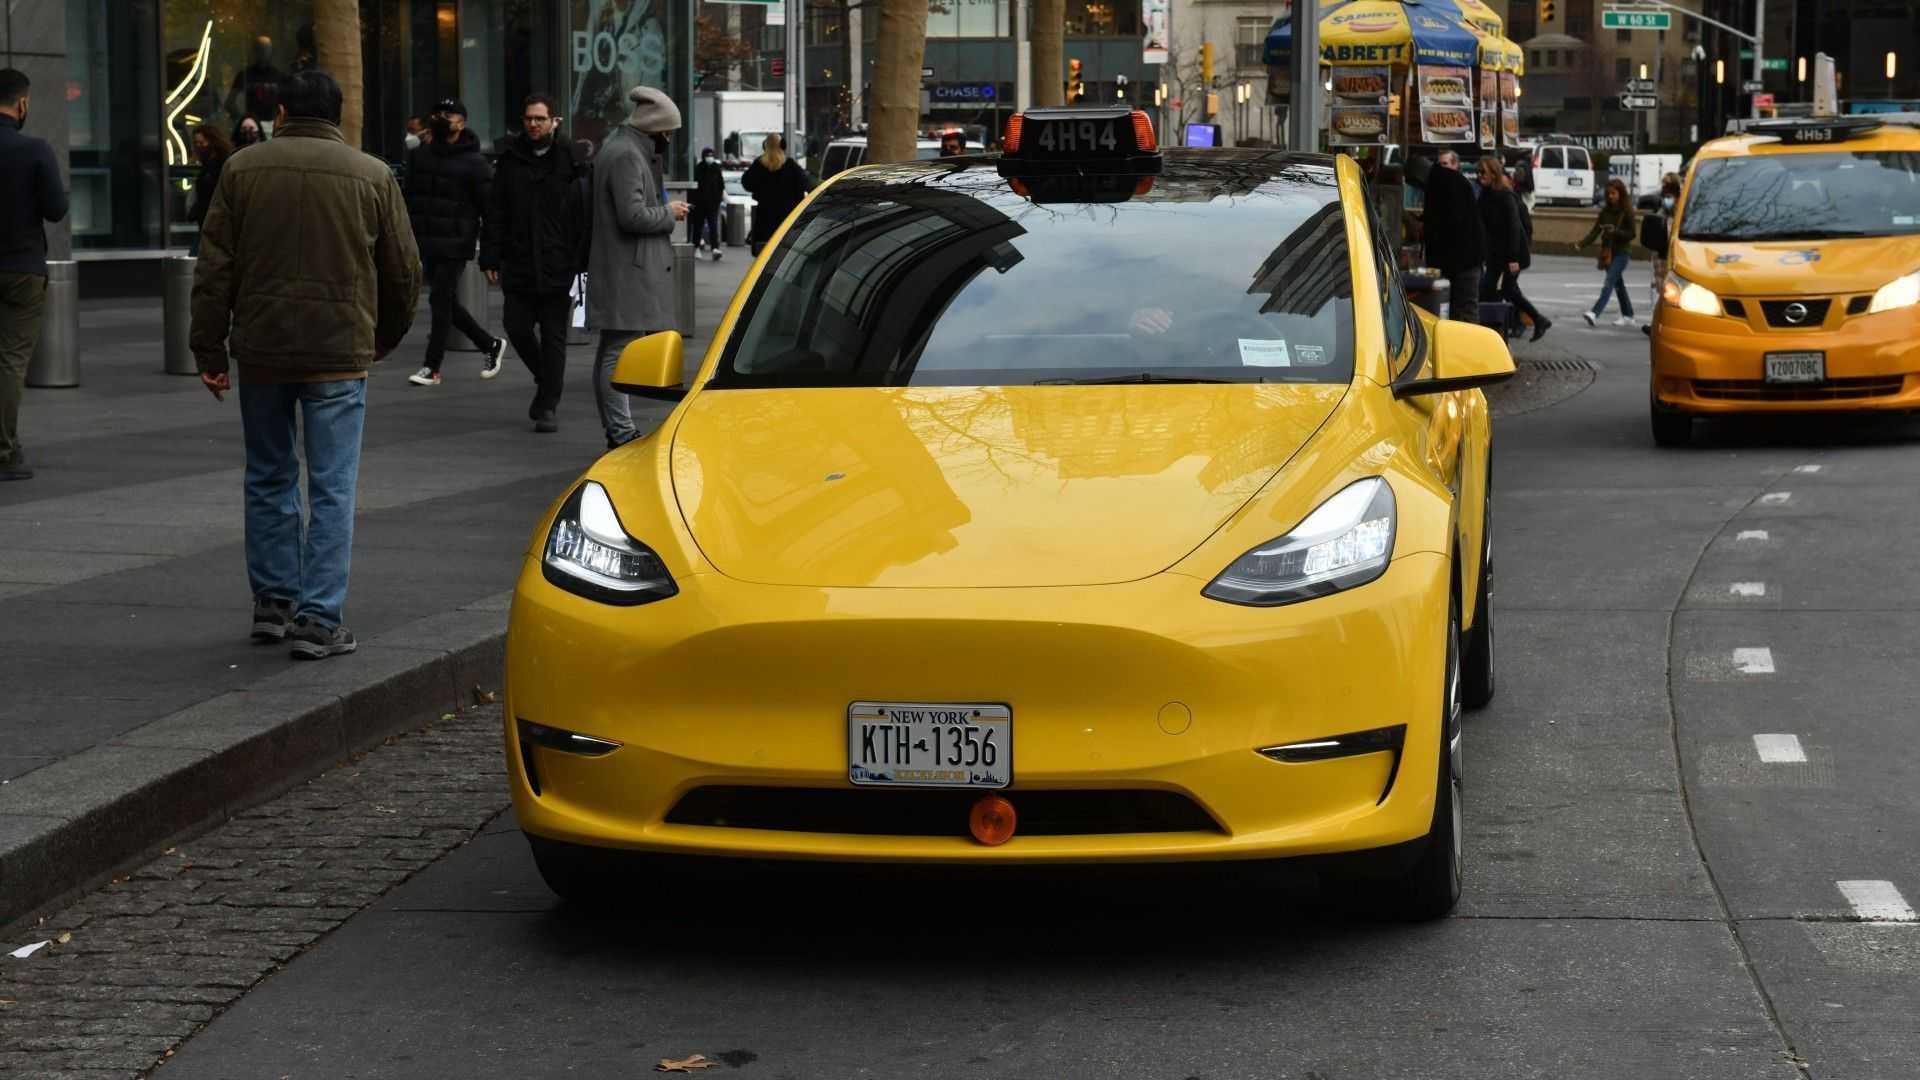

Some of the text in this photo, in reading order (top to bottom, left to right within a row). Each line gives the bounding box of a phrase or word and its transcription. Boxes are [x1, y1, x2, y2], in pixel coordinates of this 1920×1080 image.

[1617, 15, 1656, 25] W 60 St
[573, 31, 665, 73] BOSS
[936, 87, 980, 97] CHASE
[1039, 120, 1117, 151] 4H94
[1596, 135, 1631, 151] HOTEL
[890, 711, 969, 724] NEW YORK
